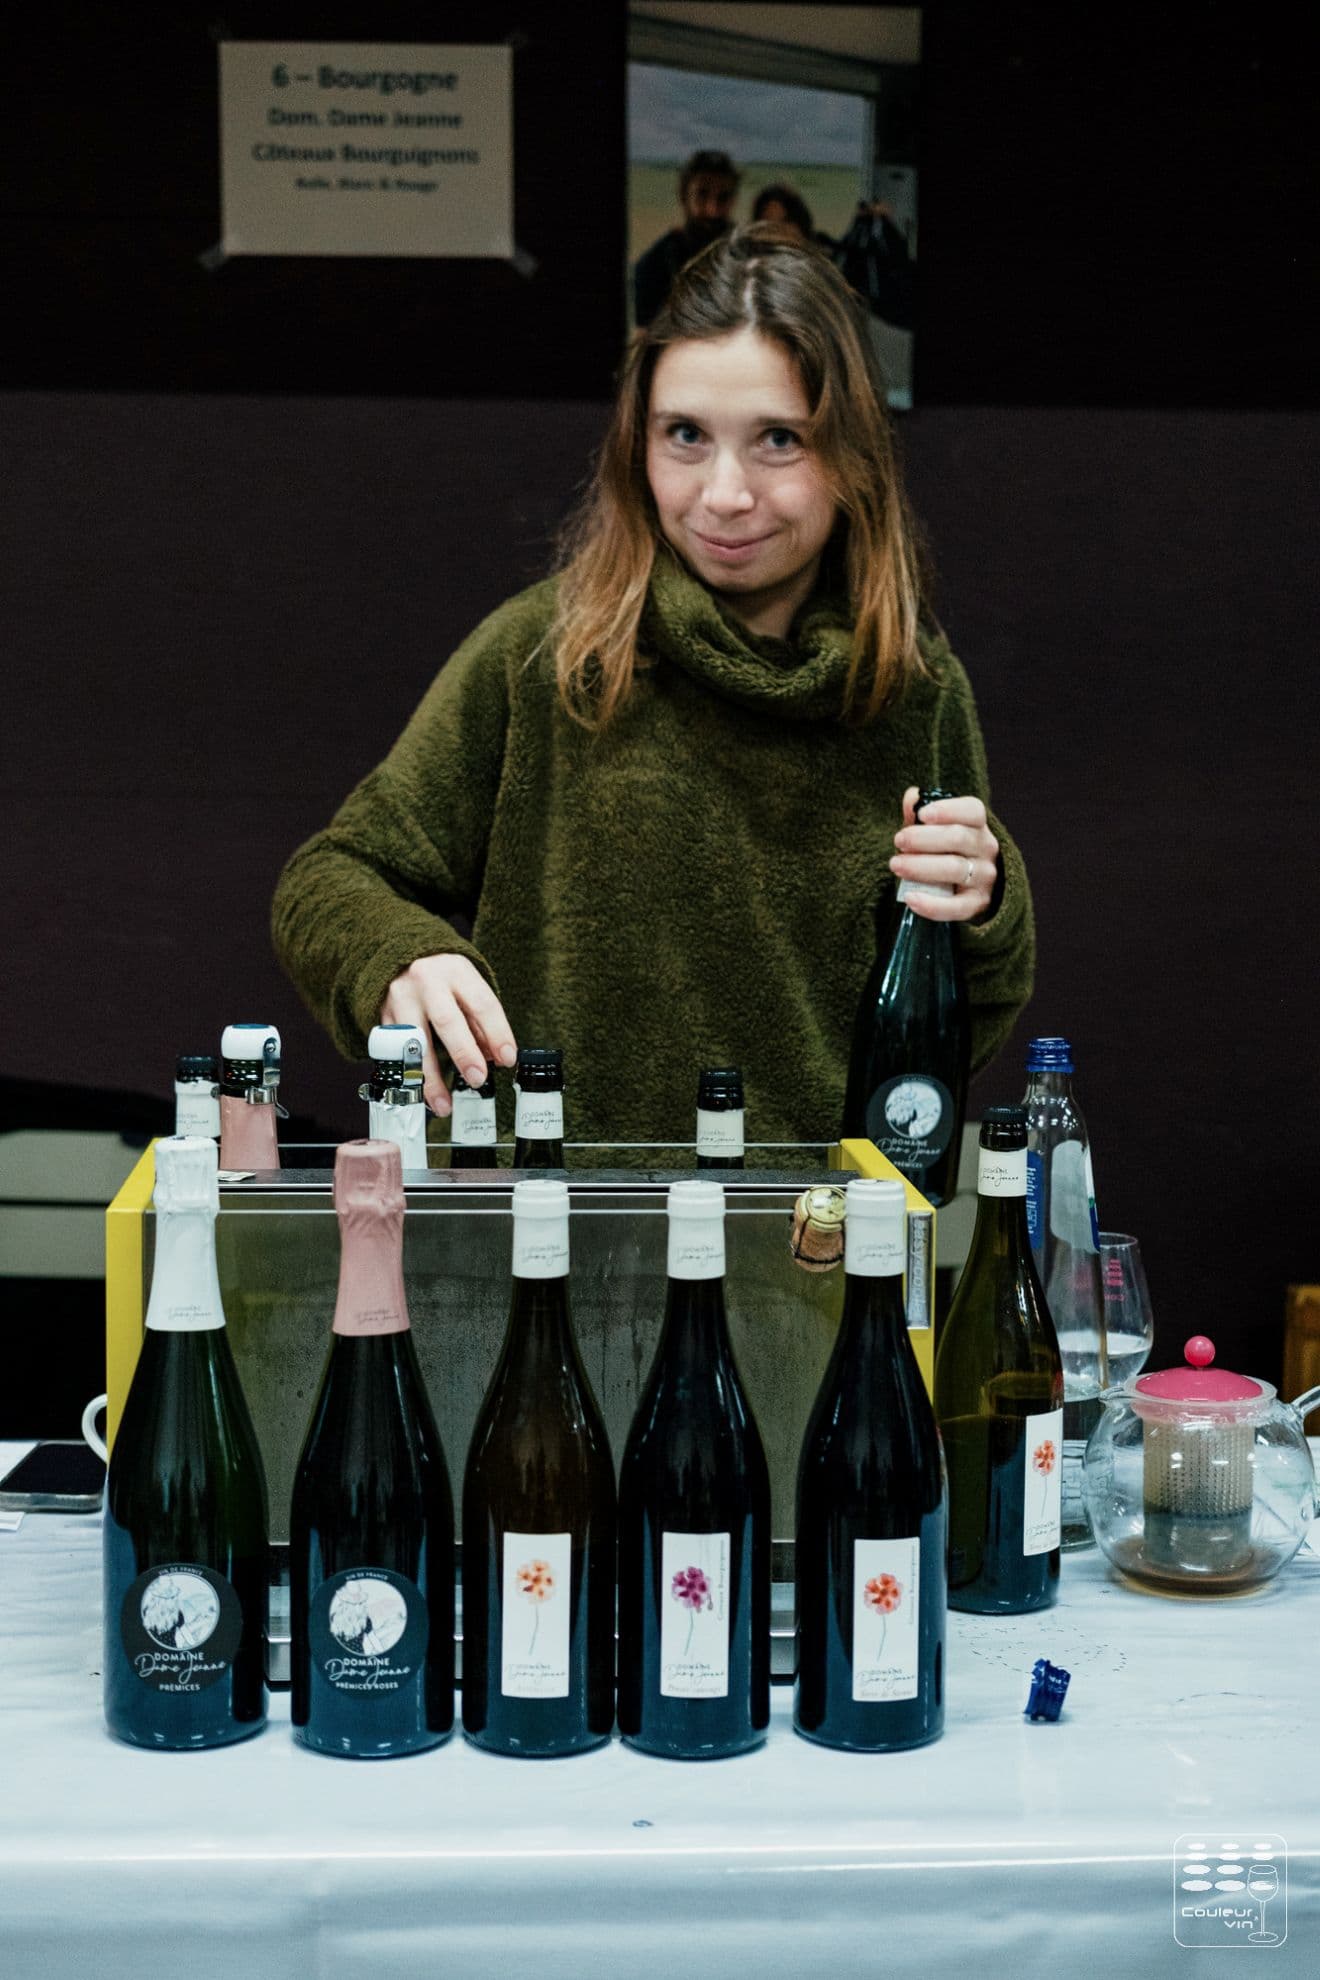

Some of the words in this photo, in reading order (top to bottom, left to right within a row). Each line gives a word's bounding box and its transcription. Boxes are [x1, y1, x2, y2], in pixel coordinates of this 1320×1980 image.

[273, 63, 289, 88] 6
[318, 65, 459, 95] Bourgogne
[327, 109, 386, 126] Dame
[134, 1653, 181, 1678] Dame
[178, 1651, 226, 1684] Jeanne
[154, 1652, 205, 1661] DOMAINE
[343, 1657, 391, 1667] DOMAINE
[324, 1658, 368, 1681] Dame
[366, 1656, 411, 1686] Jeanne
